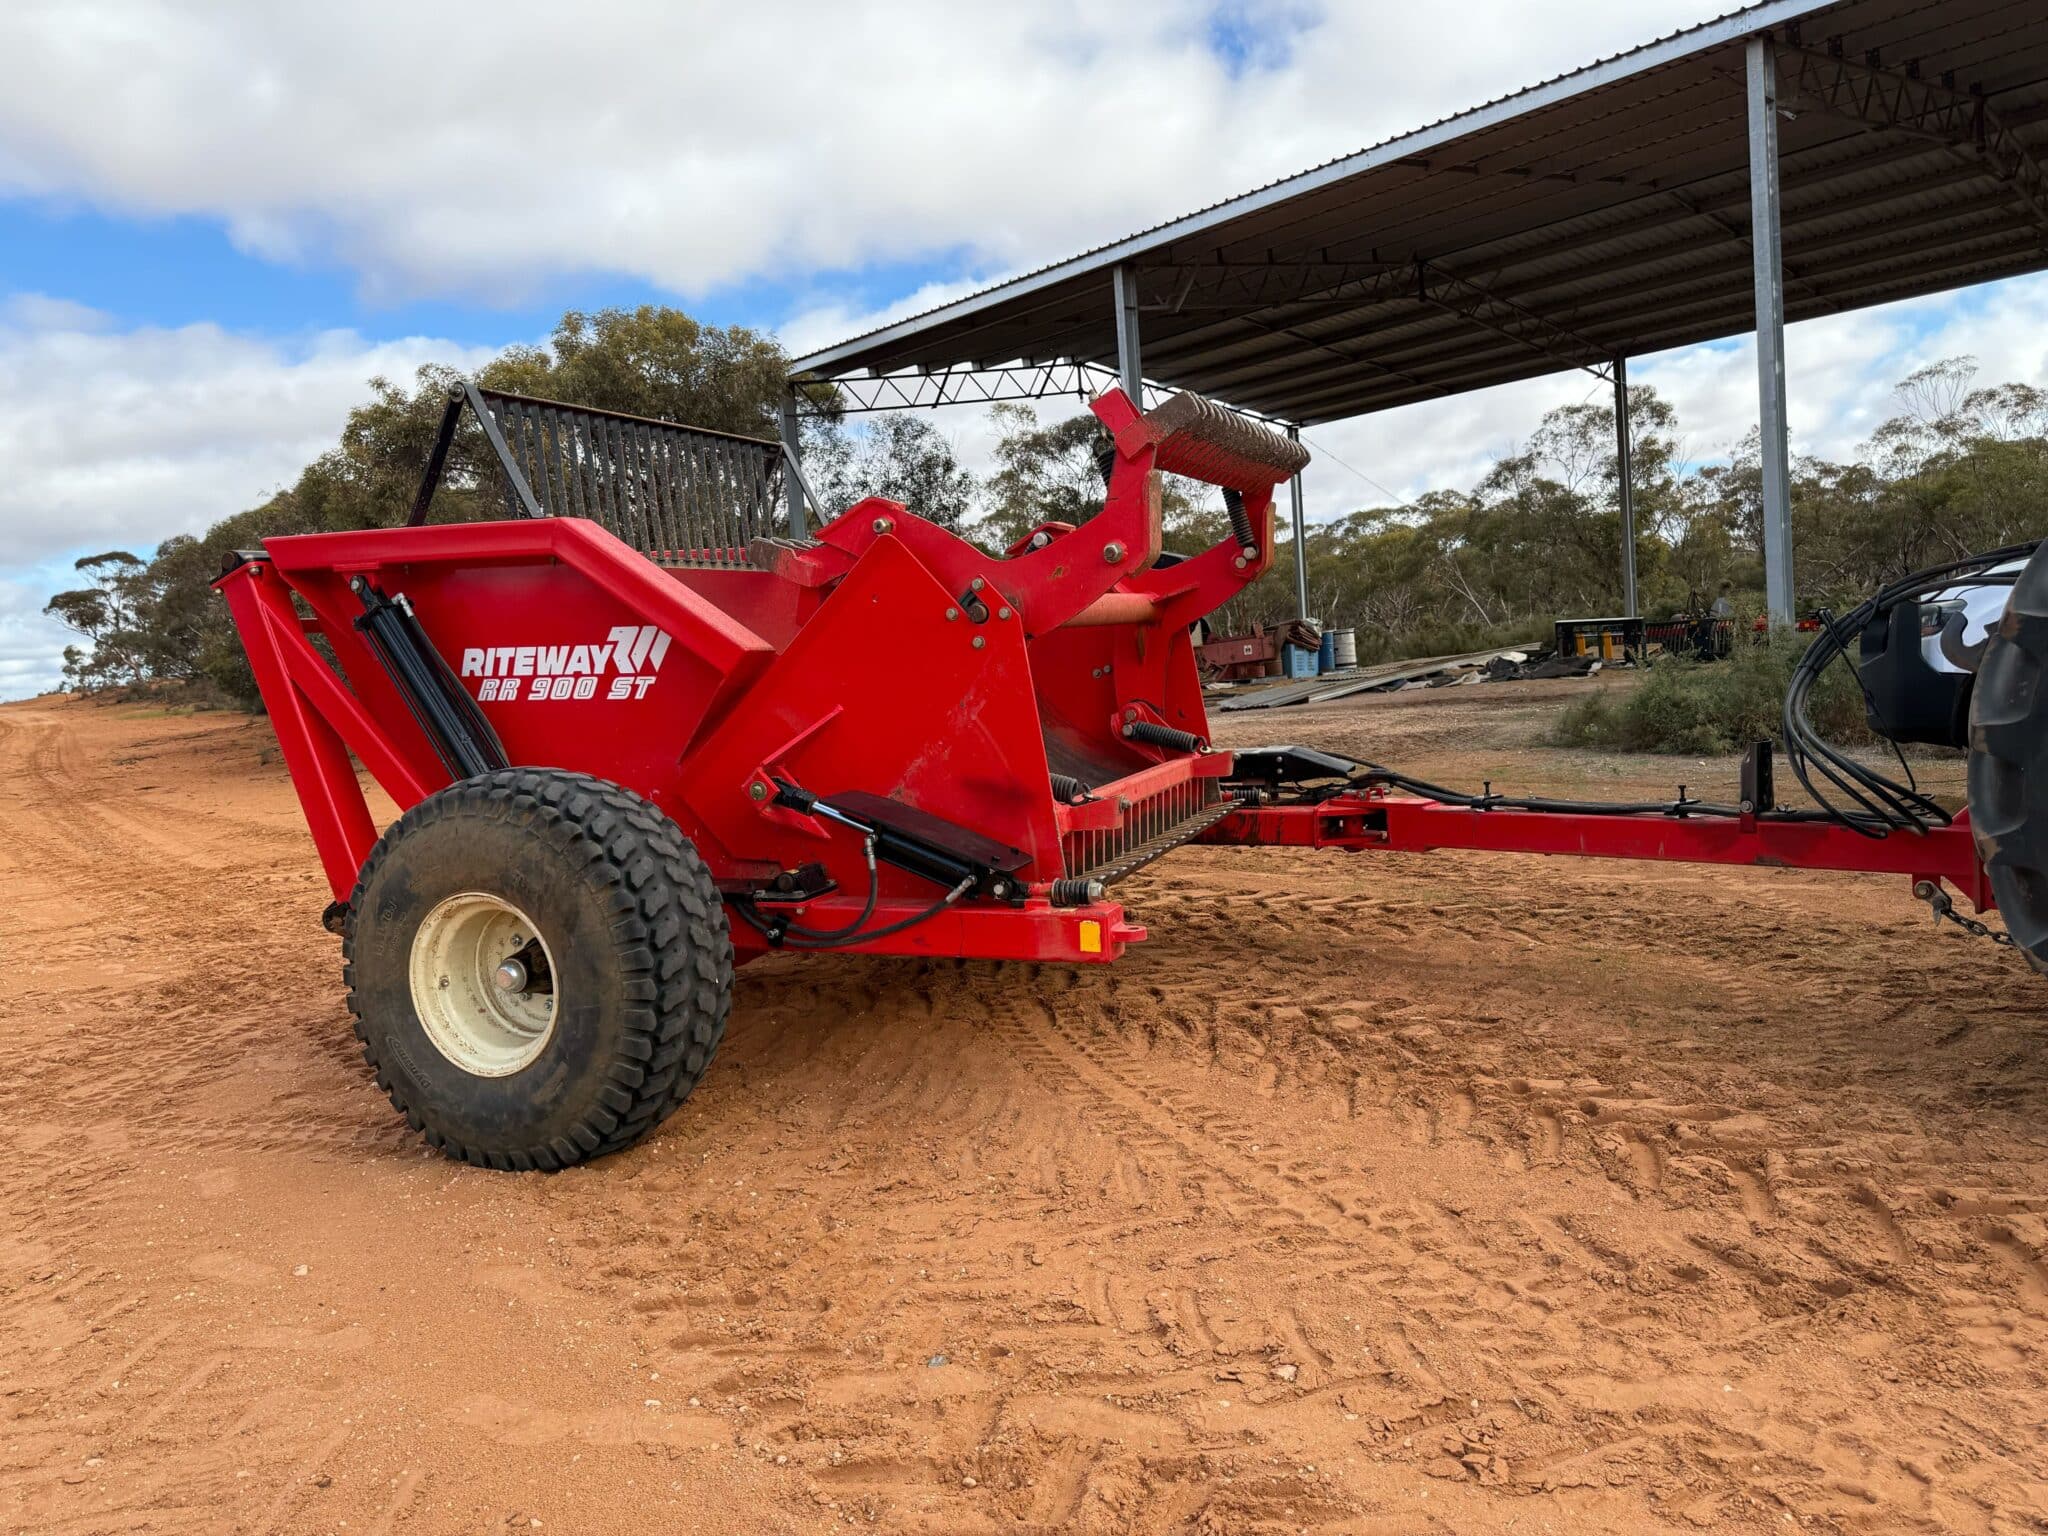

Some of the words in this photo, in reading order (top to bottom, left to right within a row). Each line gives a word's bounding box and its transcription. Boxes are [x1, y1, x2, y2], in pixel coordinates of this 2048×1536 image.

[461, 644, 614, 677] RITEWAY
[477, 678, 521, 702] RR
[527, 676, 599, 701] 900
[606, 676, 657, 701] ST
